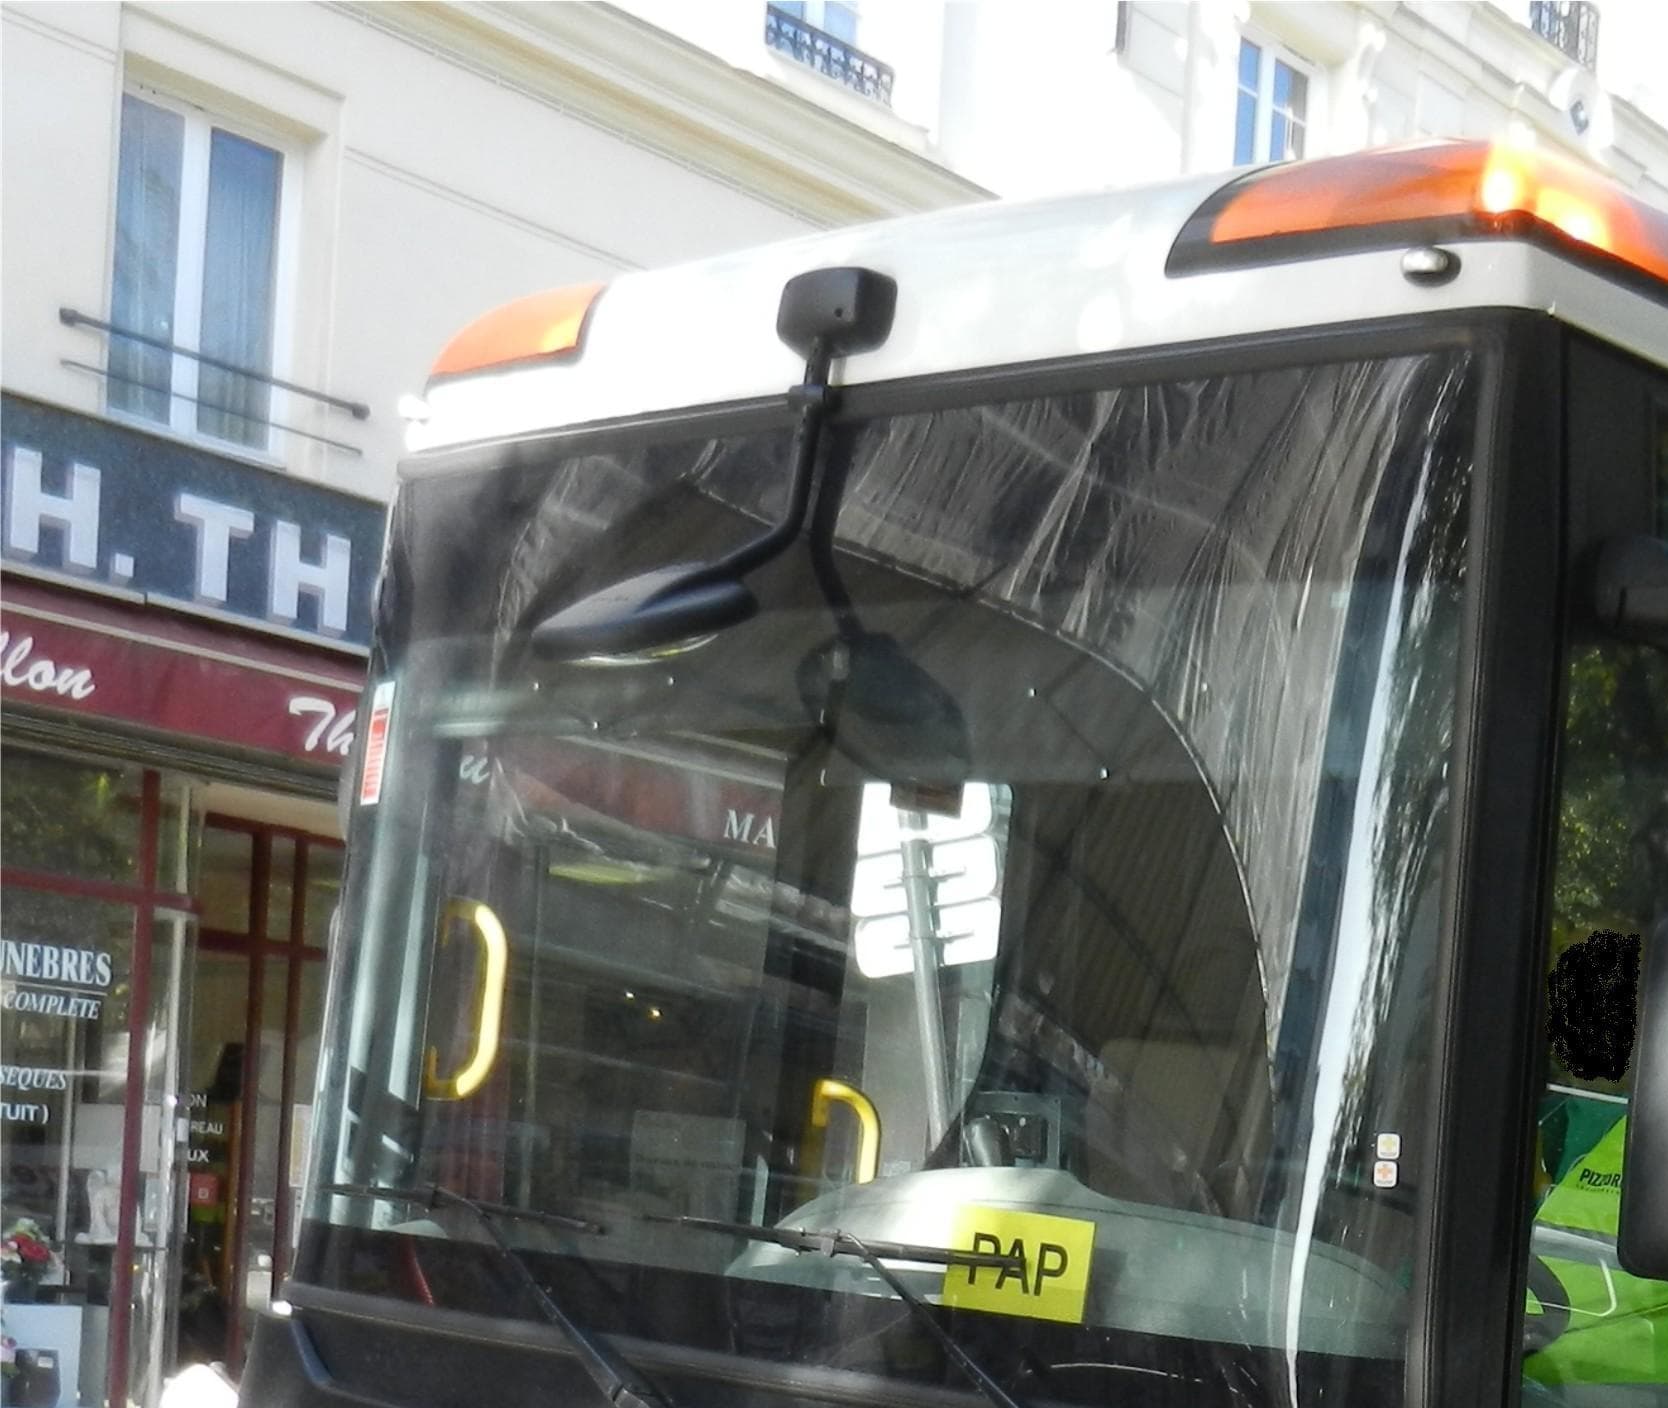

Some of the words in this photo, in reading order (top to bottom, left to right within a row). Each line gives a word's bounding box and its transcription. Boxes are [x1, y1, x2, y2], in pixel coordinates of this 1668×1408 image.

[0, 940, 112, 987] NEBRES
[5, 991, 101, 1020] COMPLETE
[968, 1232, 1068, 1296] PAP
